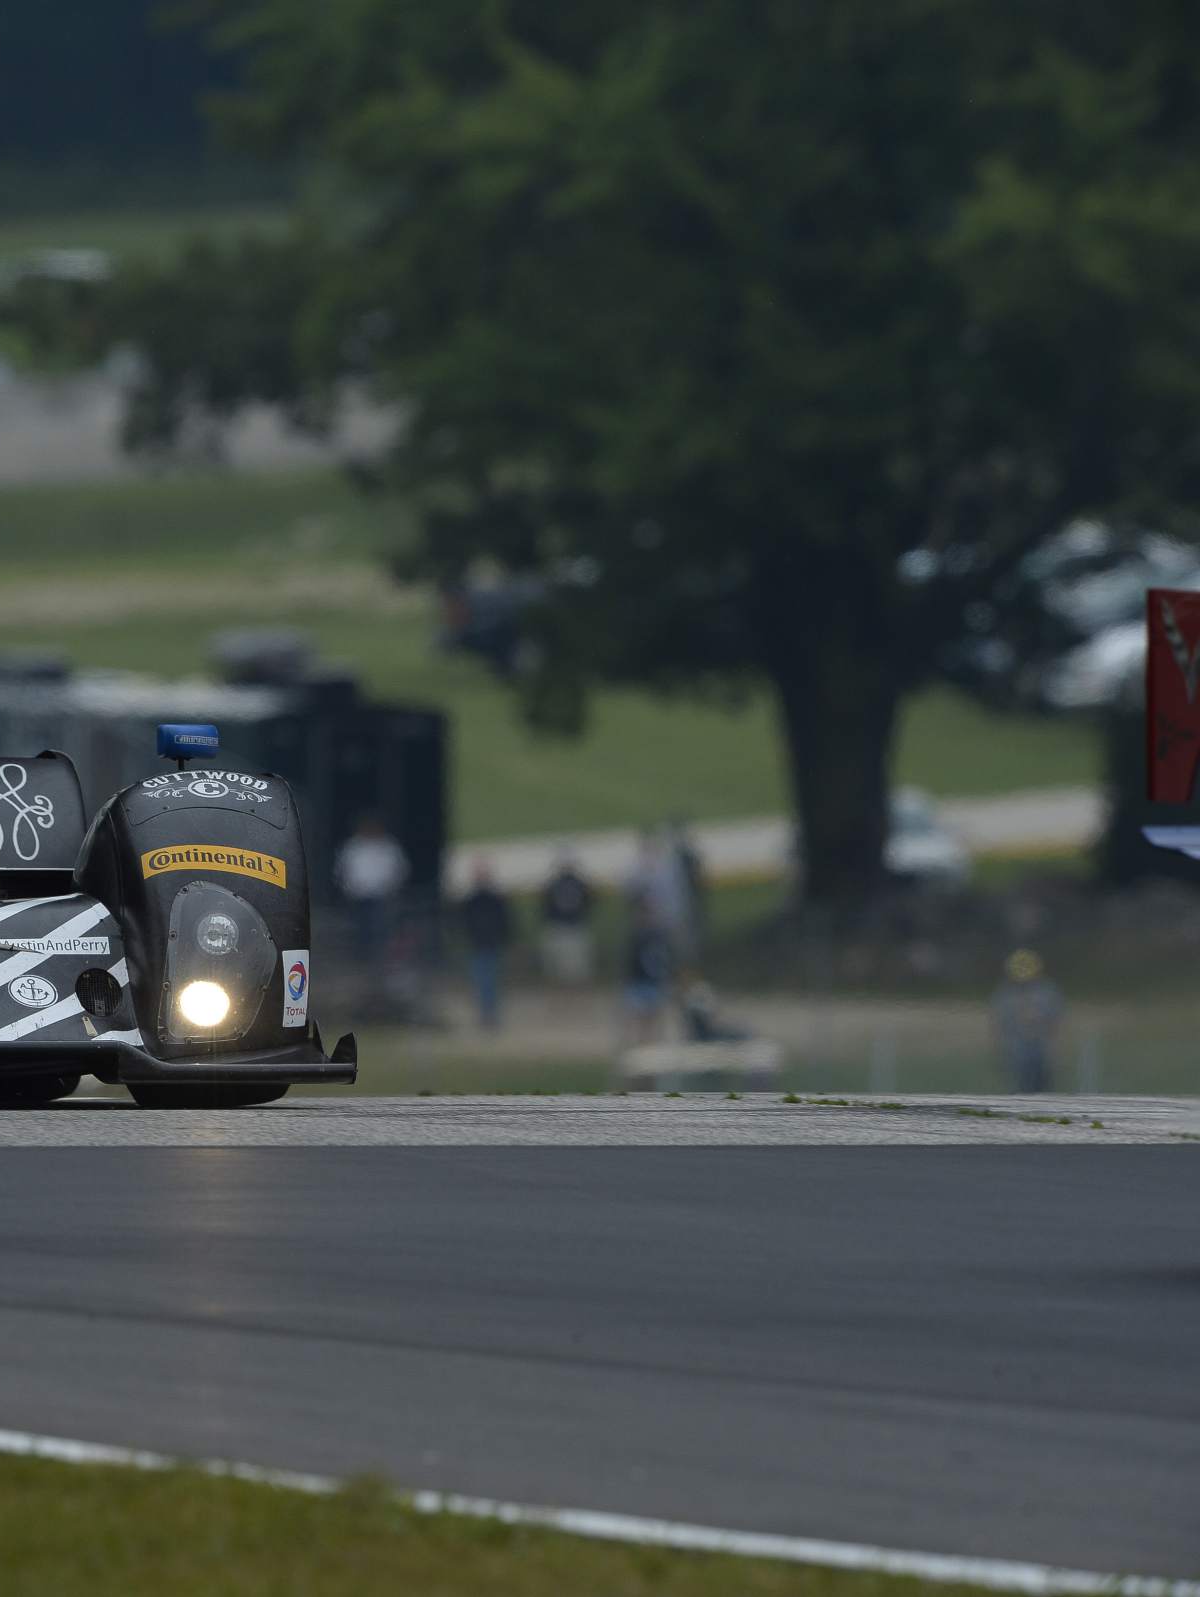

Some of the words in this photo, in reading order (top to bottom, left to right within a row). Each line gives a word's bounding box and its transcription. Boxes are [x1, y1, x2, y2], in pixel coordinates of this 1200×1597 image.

[142, 770, 268, 791] CUTTWOOD
[148, 848, 263, 872] Continental
[286, 1006, 306, 1016] TOTAL
